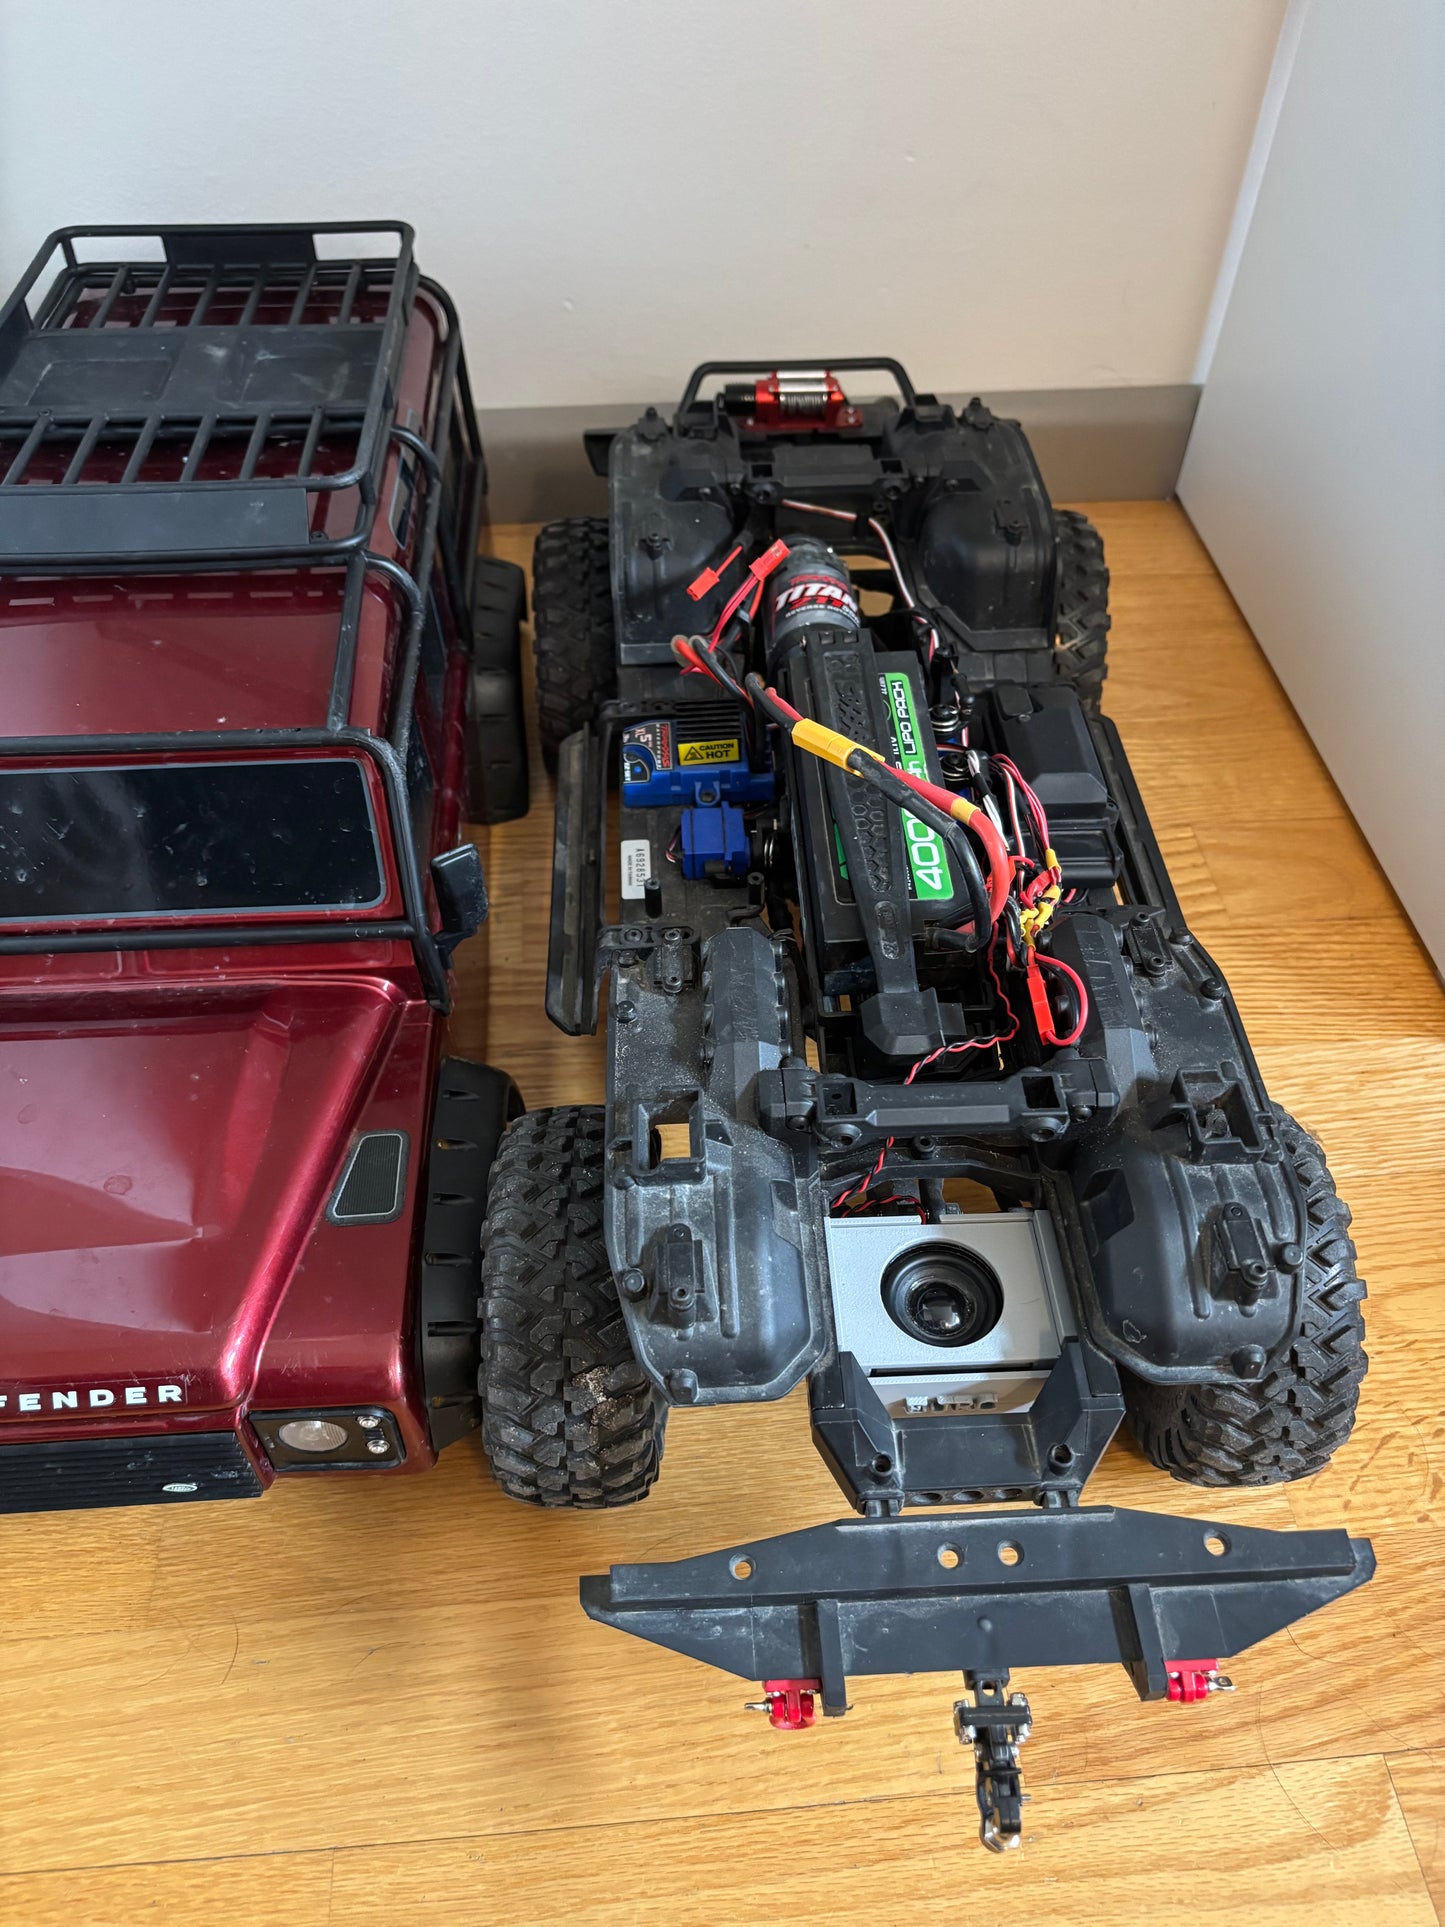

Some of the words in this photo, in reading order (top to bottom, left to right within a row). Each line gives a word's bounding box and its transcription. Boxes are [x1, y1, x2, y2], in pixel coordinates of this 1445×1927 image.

[775, 583, 858, 612] TITAN
[891, 681, 909, 718] PACK
[699, 743, 734, 751] CAUTION
[900, 721, 917, 754] LIPO
[706, 750, 730, 759] HOT
[904, 809, 943, 890] 400
